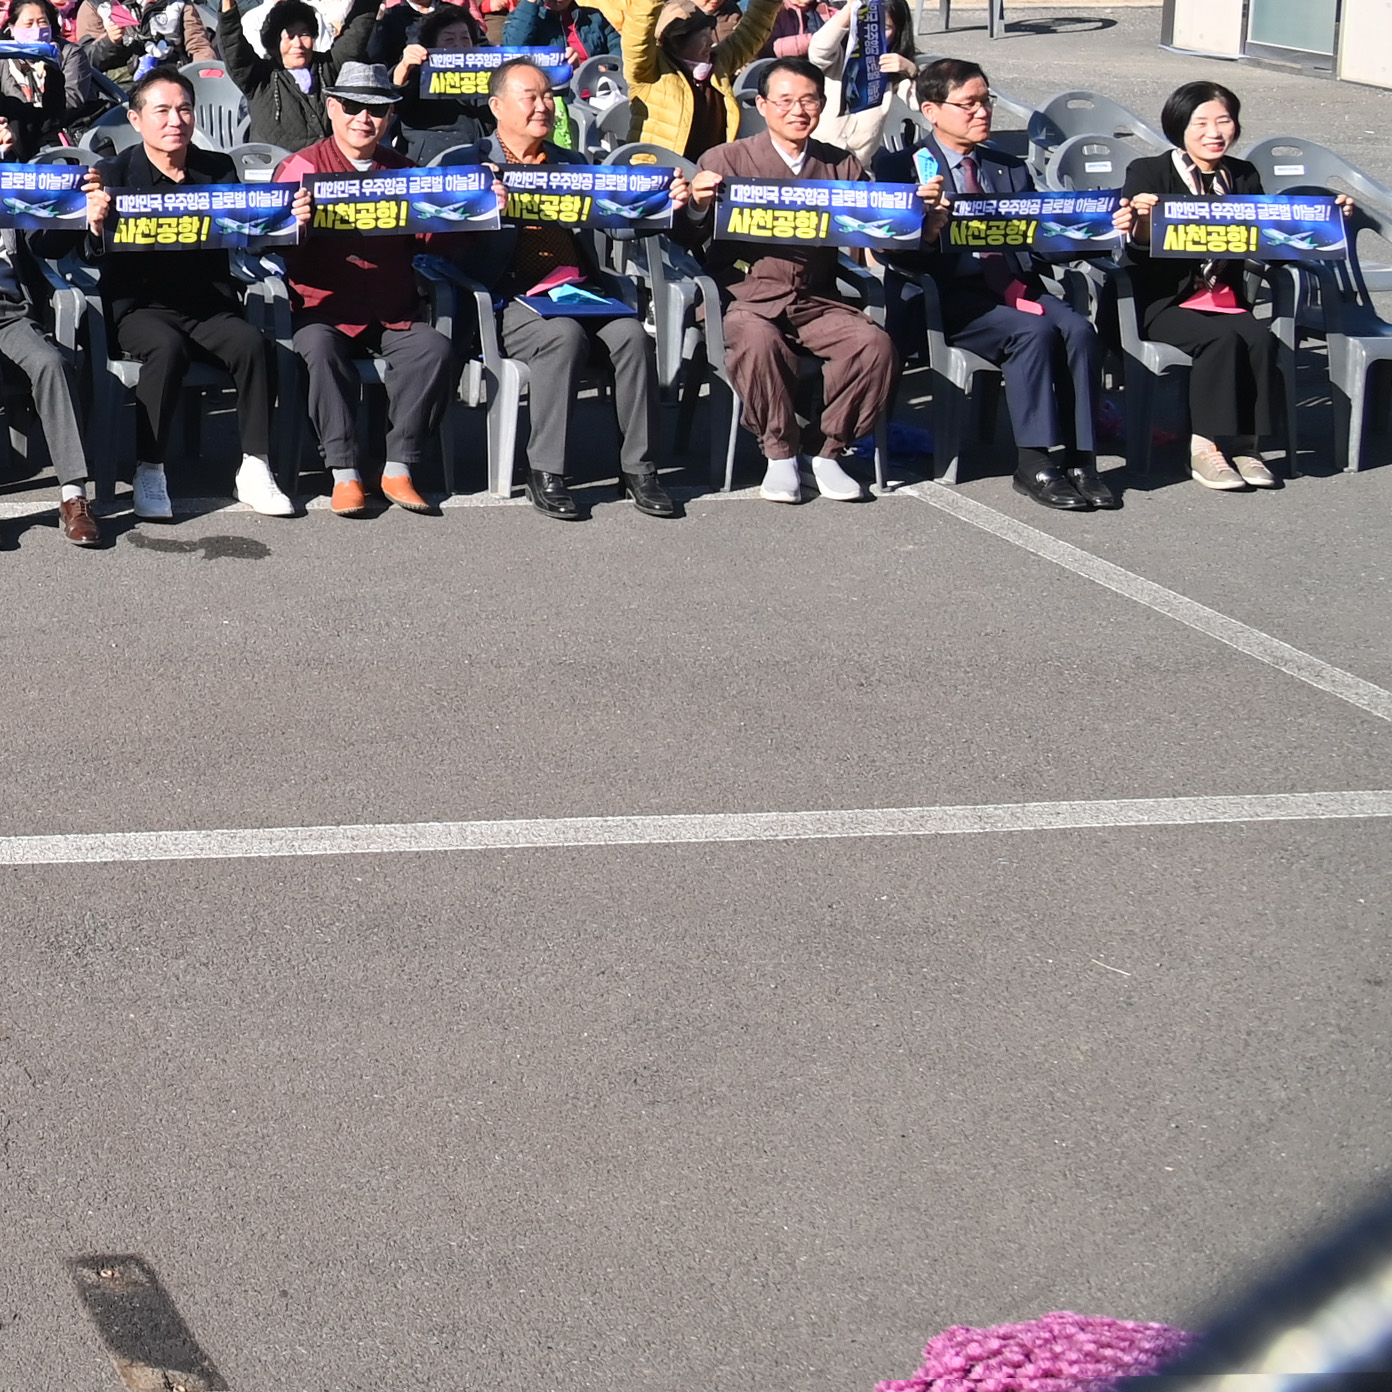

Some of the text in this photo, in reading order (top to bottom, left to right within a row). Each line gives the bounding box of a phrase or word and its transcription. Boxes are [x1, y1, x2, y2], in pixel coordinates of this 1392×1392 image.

[0, 172, 35, 189] 글로벌
[37, 173, 79, 189] 하늘길!
[314, 173, 484, 197] 대한민국 우주항공 글로벌 하늘길!
[504, 172, 667, 189] 대한민국 우주항공 글로벌 하늘길!
[117, 191, 287, 211] 대한민국 우주항공 글로벌 하늘길!
[505, 194, 591, 221] 사천공항!
[730, 185, 912, 209] 대한민국 우주항공 글로벌 하늘길!
[954, 198, 1112, 214] 대한민국 우주항공 글로벌 하늘길!
[314, 202, 406, 229] 사천공항!
[729, 209, 828, 238] 사천공항!
[1165, 202, 1329, 221] 대한민국 우주항공 글로벌 하늘길!
[115, 218, 207, 243] 사천공항!
[950, 220, 1037, 245] 사천공항!
[1165, 226, 1257, 251] 사천공항!
